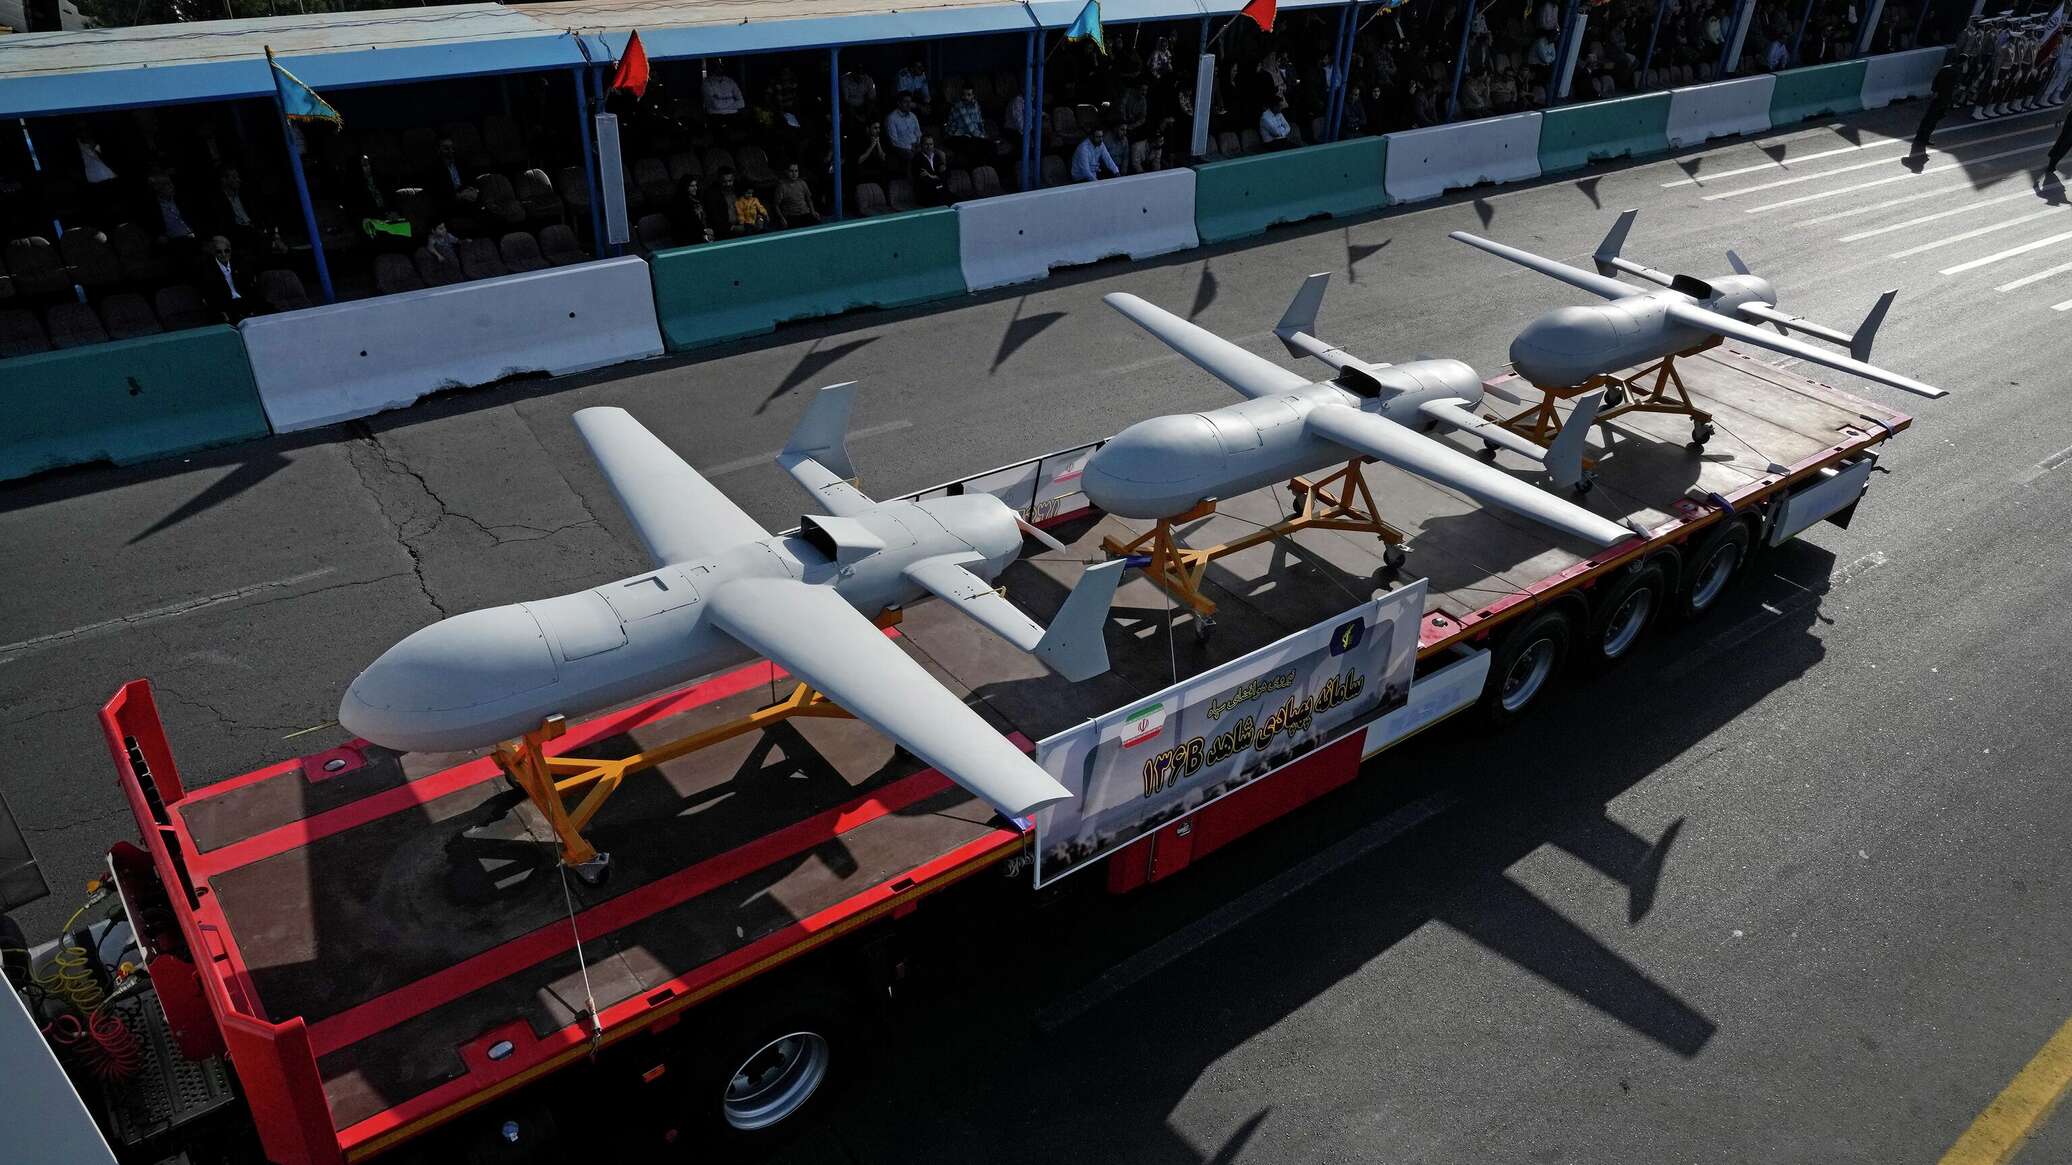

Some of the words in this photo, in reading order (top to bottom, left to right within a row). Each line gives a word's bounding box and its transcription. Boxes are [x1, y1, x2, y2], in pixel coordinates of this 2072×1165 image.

[1314, 667, 1365, 713] سامانه
[1206, 715, 1255, 766] شاهد
[1255, 696, 1314, 751] پهپادی
[1143, 736, 1205, 798] ۱۳۶B
